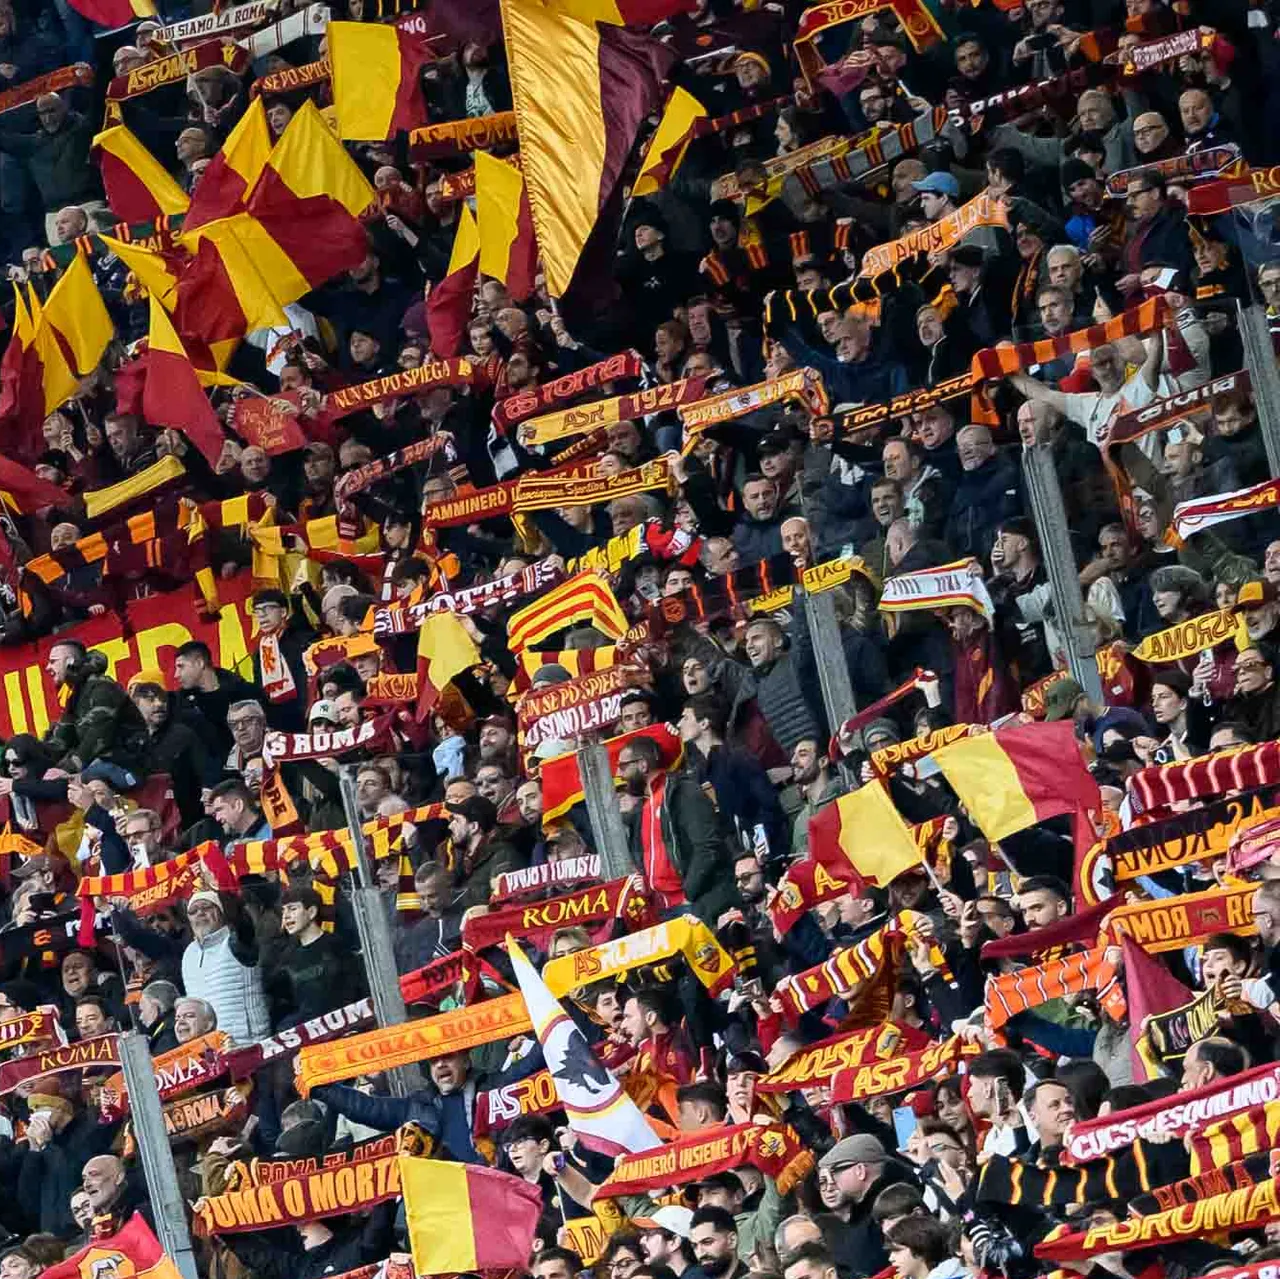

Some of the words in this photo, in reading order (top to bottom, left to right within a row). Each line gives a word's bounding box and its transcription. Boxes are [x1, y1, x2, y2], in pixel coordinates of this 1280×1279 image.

[180, 14, 214, 37] SIAMO
[216, 10, 231, 30] LA
[233, 3, 266, 27] ROMA
[128, 50, 199, 93] ASROMA
[367, 375, 384, 401] SE
[403, 360, 450, 392] SPIEGA
[541, 354, 625, 407] roma
[561, 398, 607, 433] ASR
[629, 377, 686, 419] 1927
[564, 475, 607, 498] Sportiva
[608, 471, 638, 492] Roma
[412, 574, 516, 618] TOTTI
[522, 888, 611, 931] ROMA
[574, 942, 601, 979] AS
[601, 918, 672, 971] ROMA
[262, 1019, 304, 1059] AS
[438, 998, 516, 1046] ROMA
[40, 1036, 115, 1071] ROMA
[852, 1055, 909, 1104] ASR
[184, 1097, 222, 1131] ROMA
[488, 1078, 523, 1125] AS
[1071, 1108, 1141, 1163] CUCS
[1157, 1066, 1280, 1138] ESQUILINO
[285, 1177, 304, 1218] O
